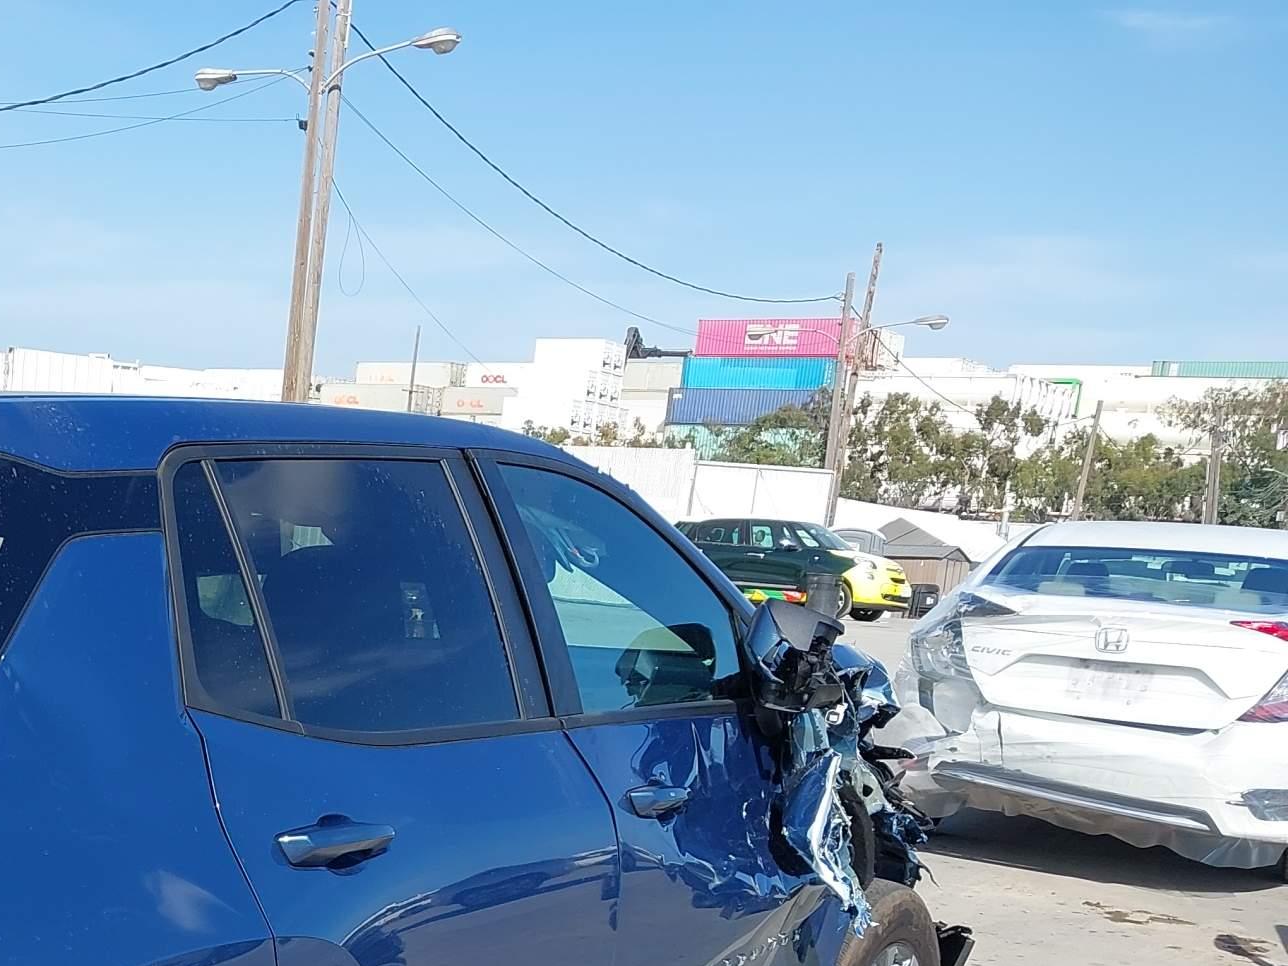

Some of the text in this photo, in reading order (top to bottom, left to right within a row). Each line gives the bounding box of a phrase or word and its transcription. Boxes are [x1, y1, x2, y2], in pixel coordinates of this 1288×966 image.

[480, 374, 508, 384] OOCL
[457, 400, 484, 408] OCL
[971, 645, 1012, 656] CIVIC
